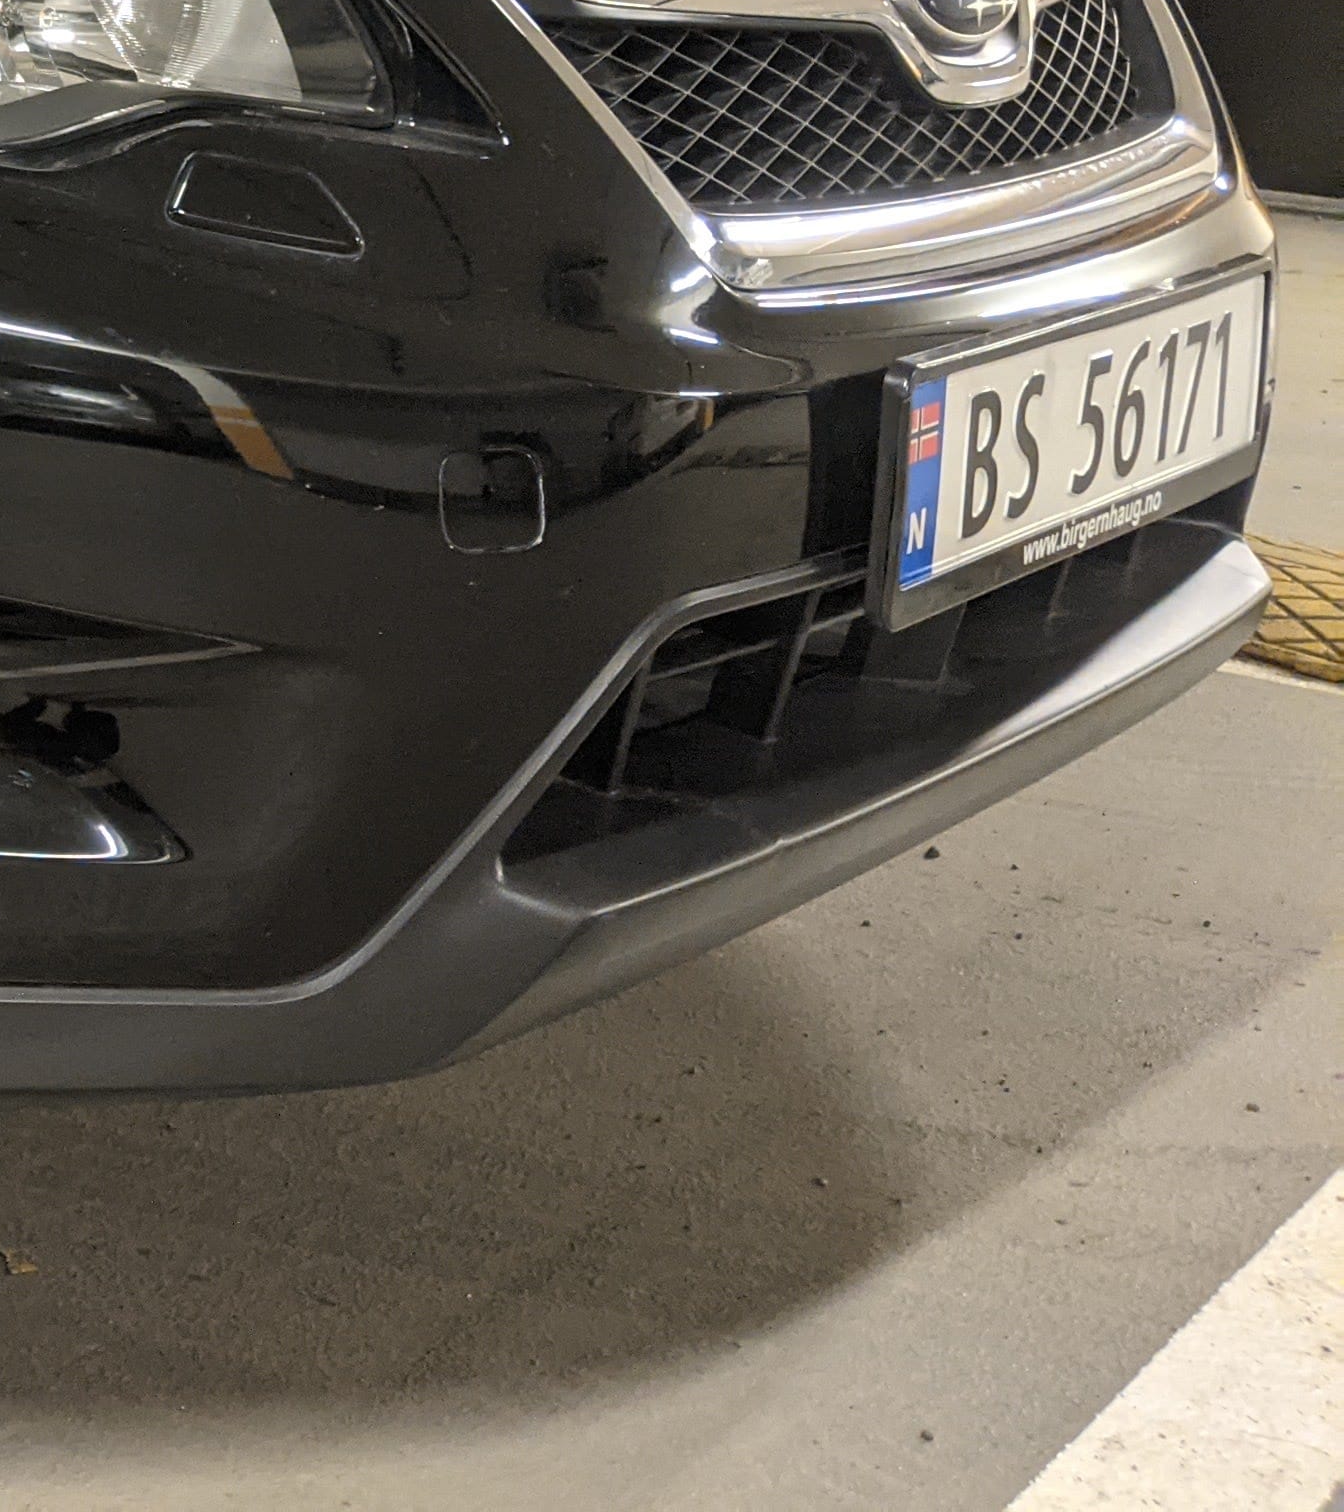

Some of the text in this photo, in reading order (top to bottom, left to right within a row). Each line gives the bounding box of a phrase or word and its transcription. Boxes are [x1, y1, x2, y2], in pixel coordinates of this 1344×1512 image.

[962, 311, 1232, 538] BS 56171
[907, 508, 927, 553] N
[1023, 491, 1162, 565] www.birgernhaug.no
